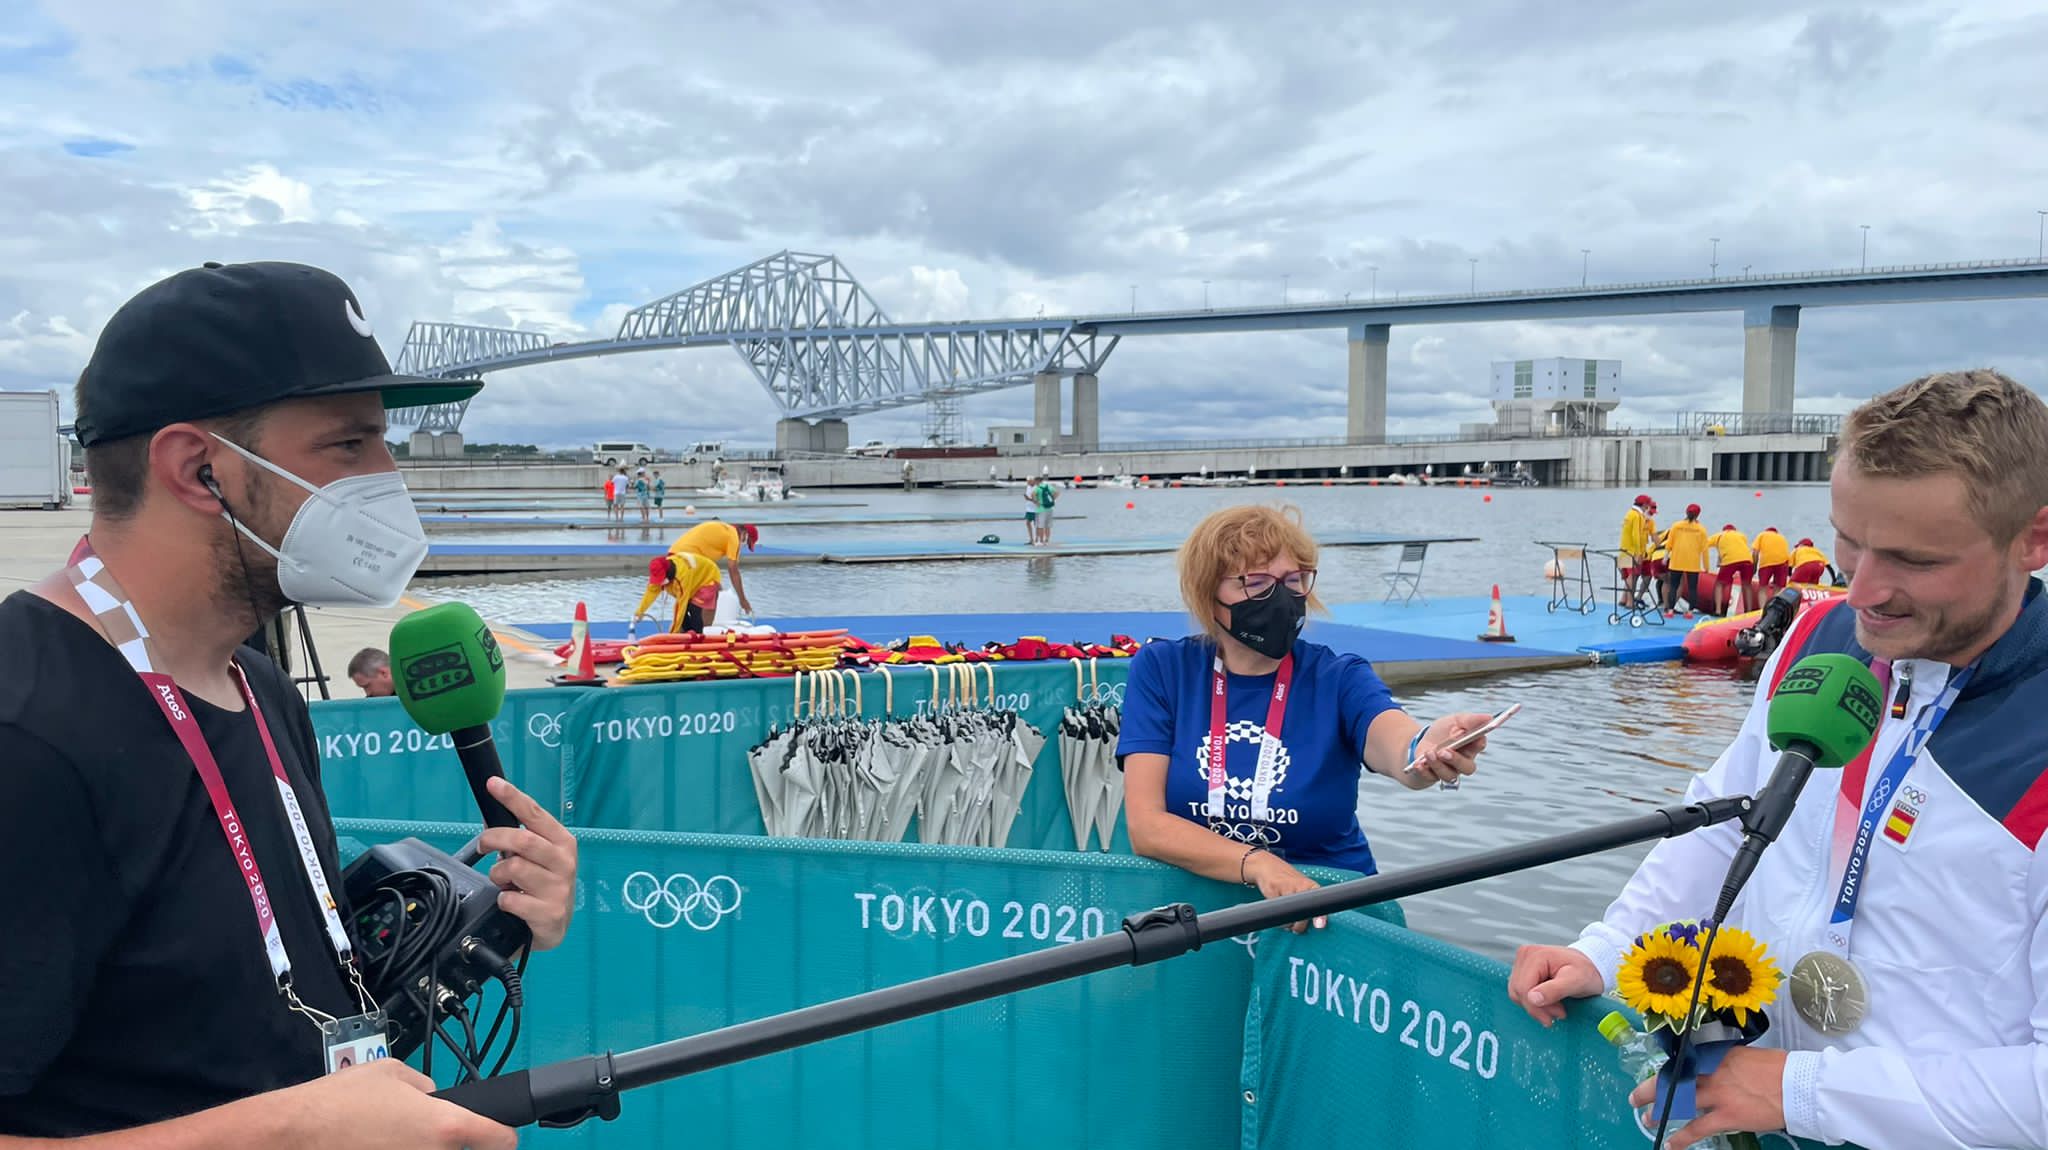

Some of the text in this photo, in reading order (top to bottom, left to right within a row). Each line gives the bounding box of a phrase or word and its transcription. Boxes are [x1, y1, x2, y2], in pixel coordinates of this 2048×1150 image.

[156, 684, 187, 721] Atos
[592, 715, 673, 743] TOKYO
[679, 711, 735, 736] 2020
[316, 732, 381, 758] KYO
[1212, 735, 1223, 784] TOKYO 2020
[1257, 760, 1271, 786] TOKYO
[1188, 802, 1299, 824] TOYO 020
[223, 810, 270, 919] TOKYO 2020
[285, 791, 325, 890] TOKYO 2020
[1841, 820, 1872, 904] TOKYO 2020
[854, 893, 1104, 943] TOKYO 2020
[1289, 956, 1499, 1079] TOKYO 2020
